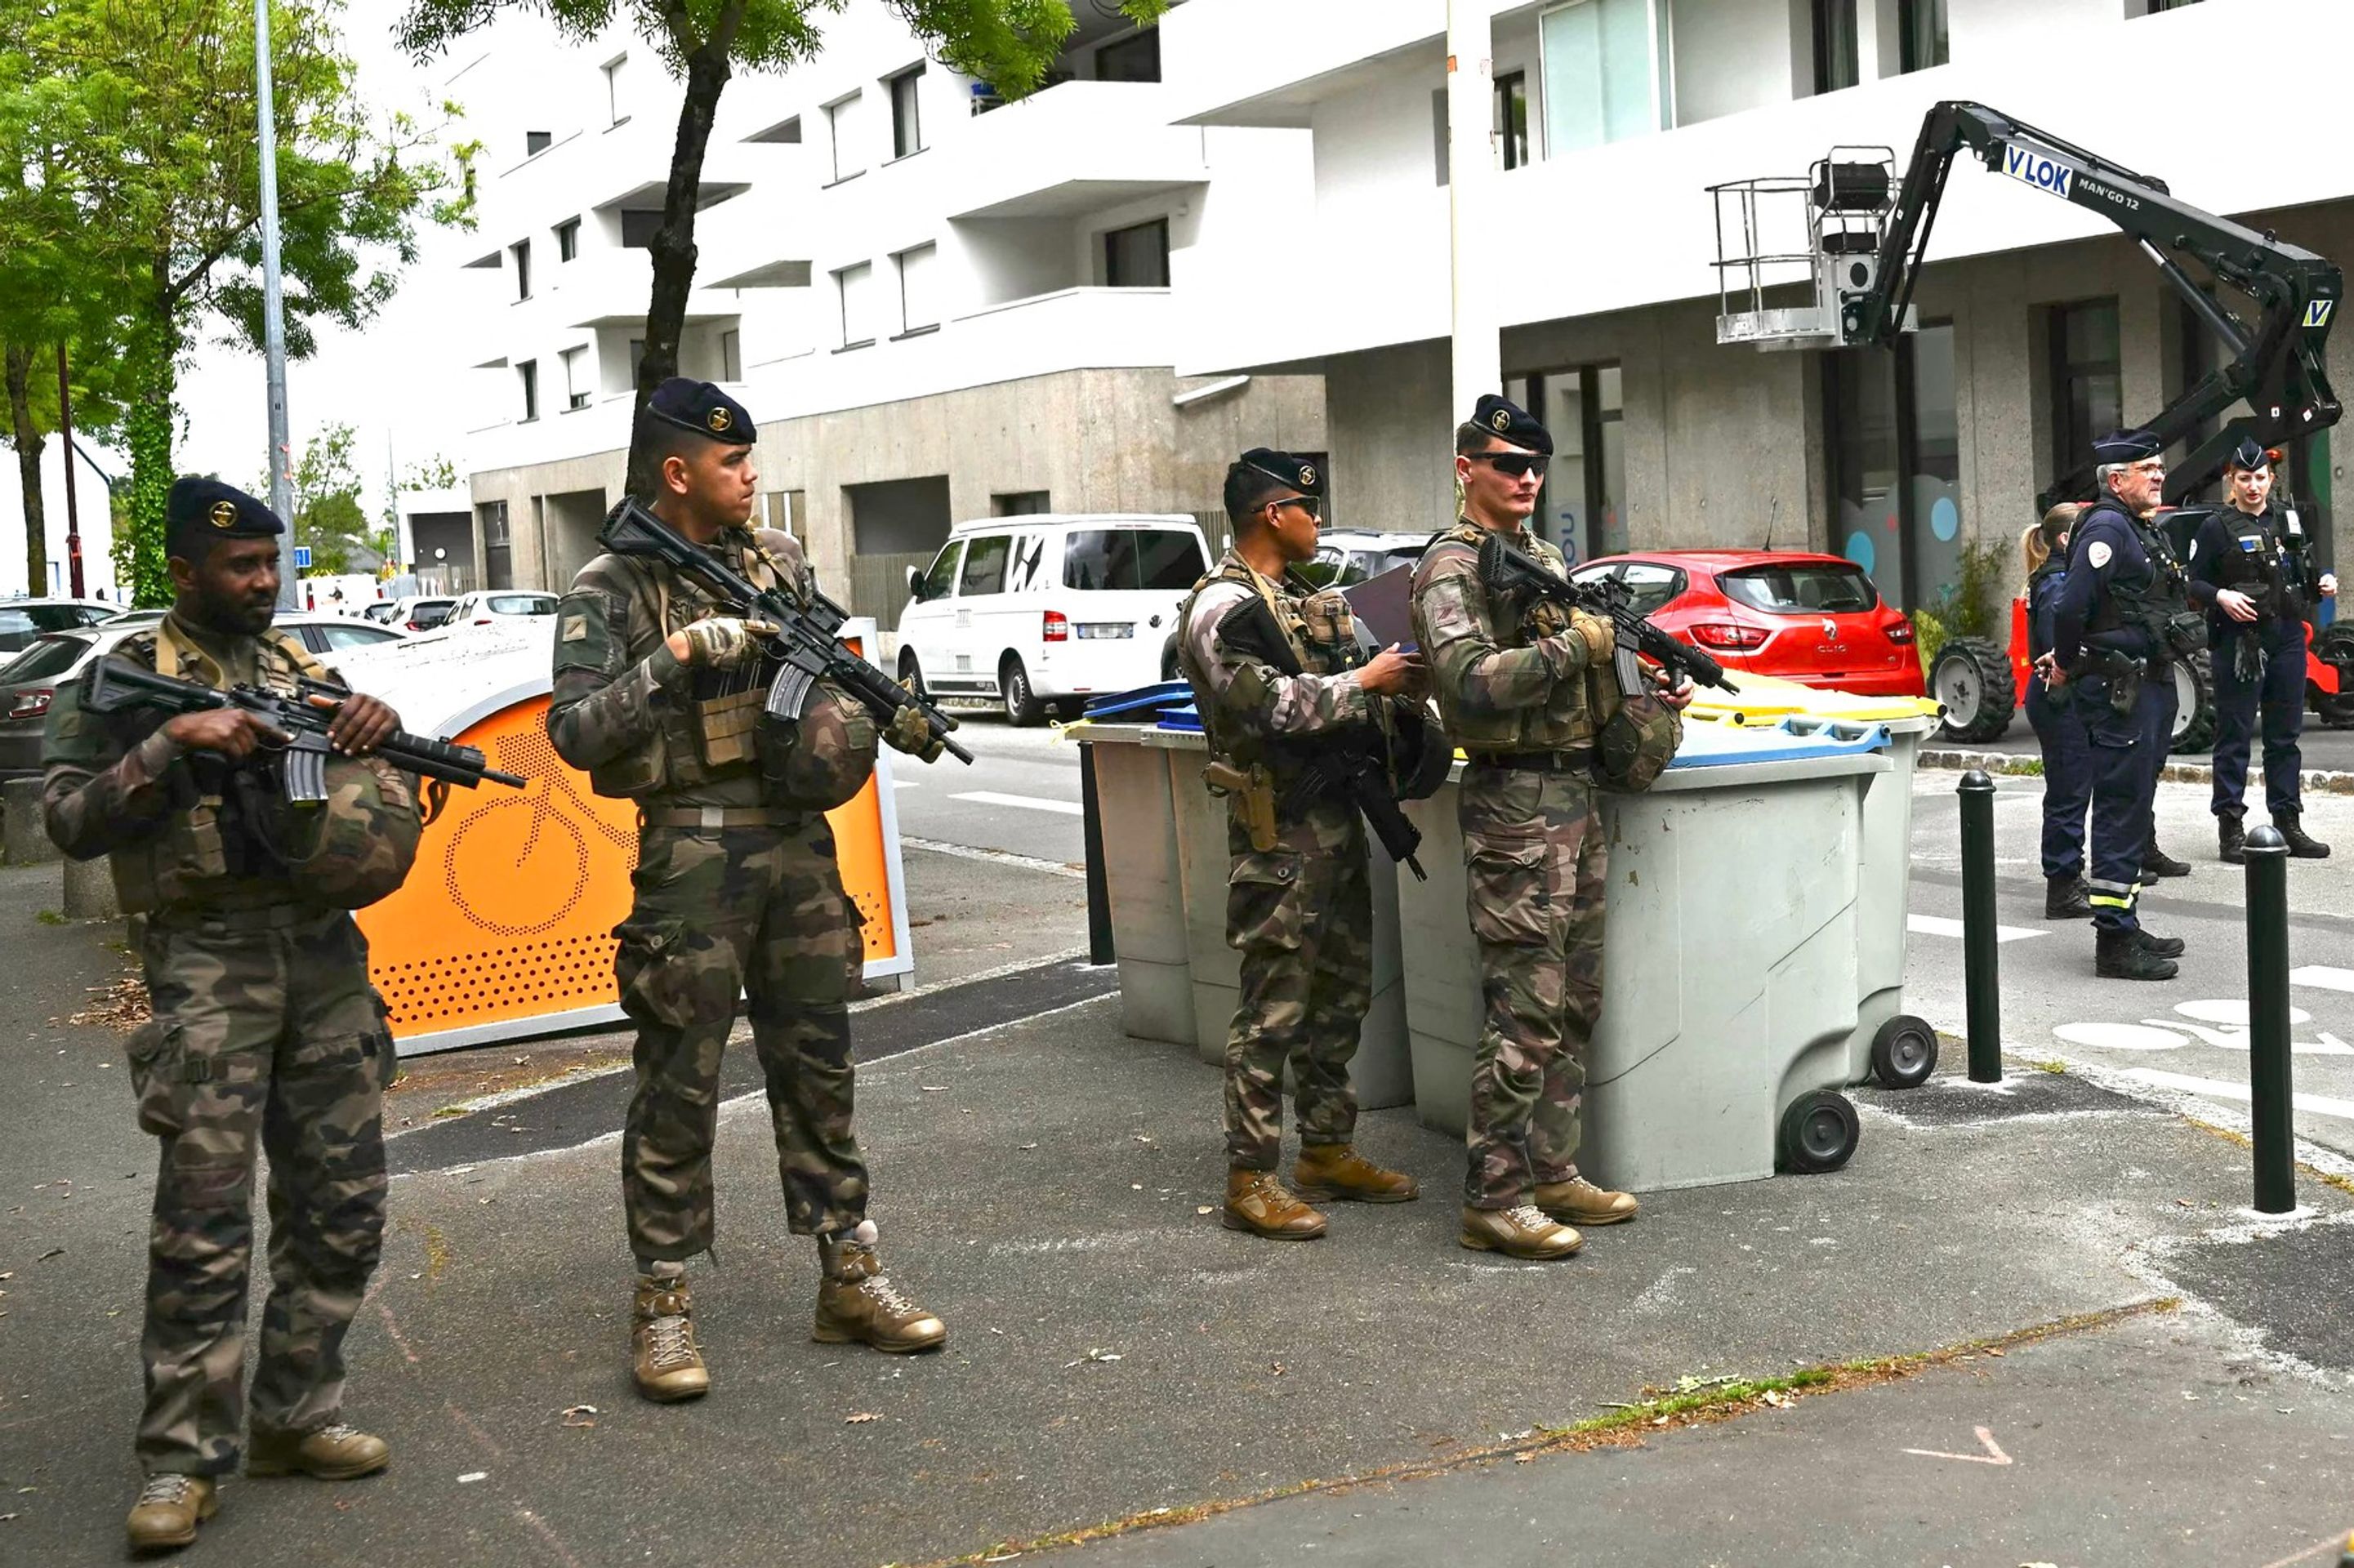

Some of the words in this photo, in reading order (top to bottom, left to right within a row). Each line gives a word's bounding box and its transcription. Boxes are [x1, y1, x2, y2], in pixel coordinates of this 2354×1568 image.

[2078, 179, 2124, 204] MAN'GO
[2126, 198, 2139, 210] 12
[2311, 302, 2330, 324] V
[1817, 644, 1846, 653] CLIO
